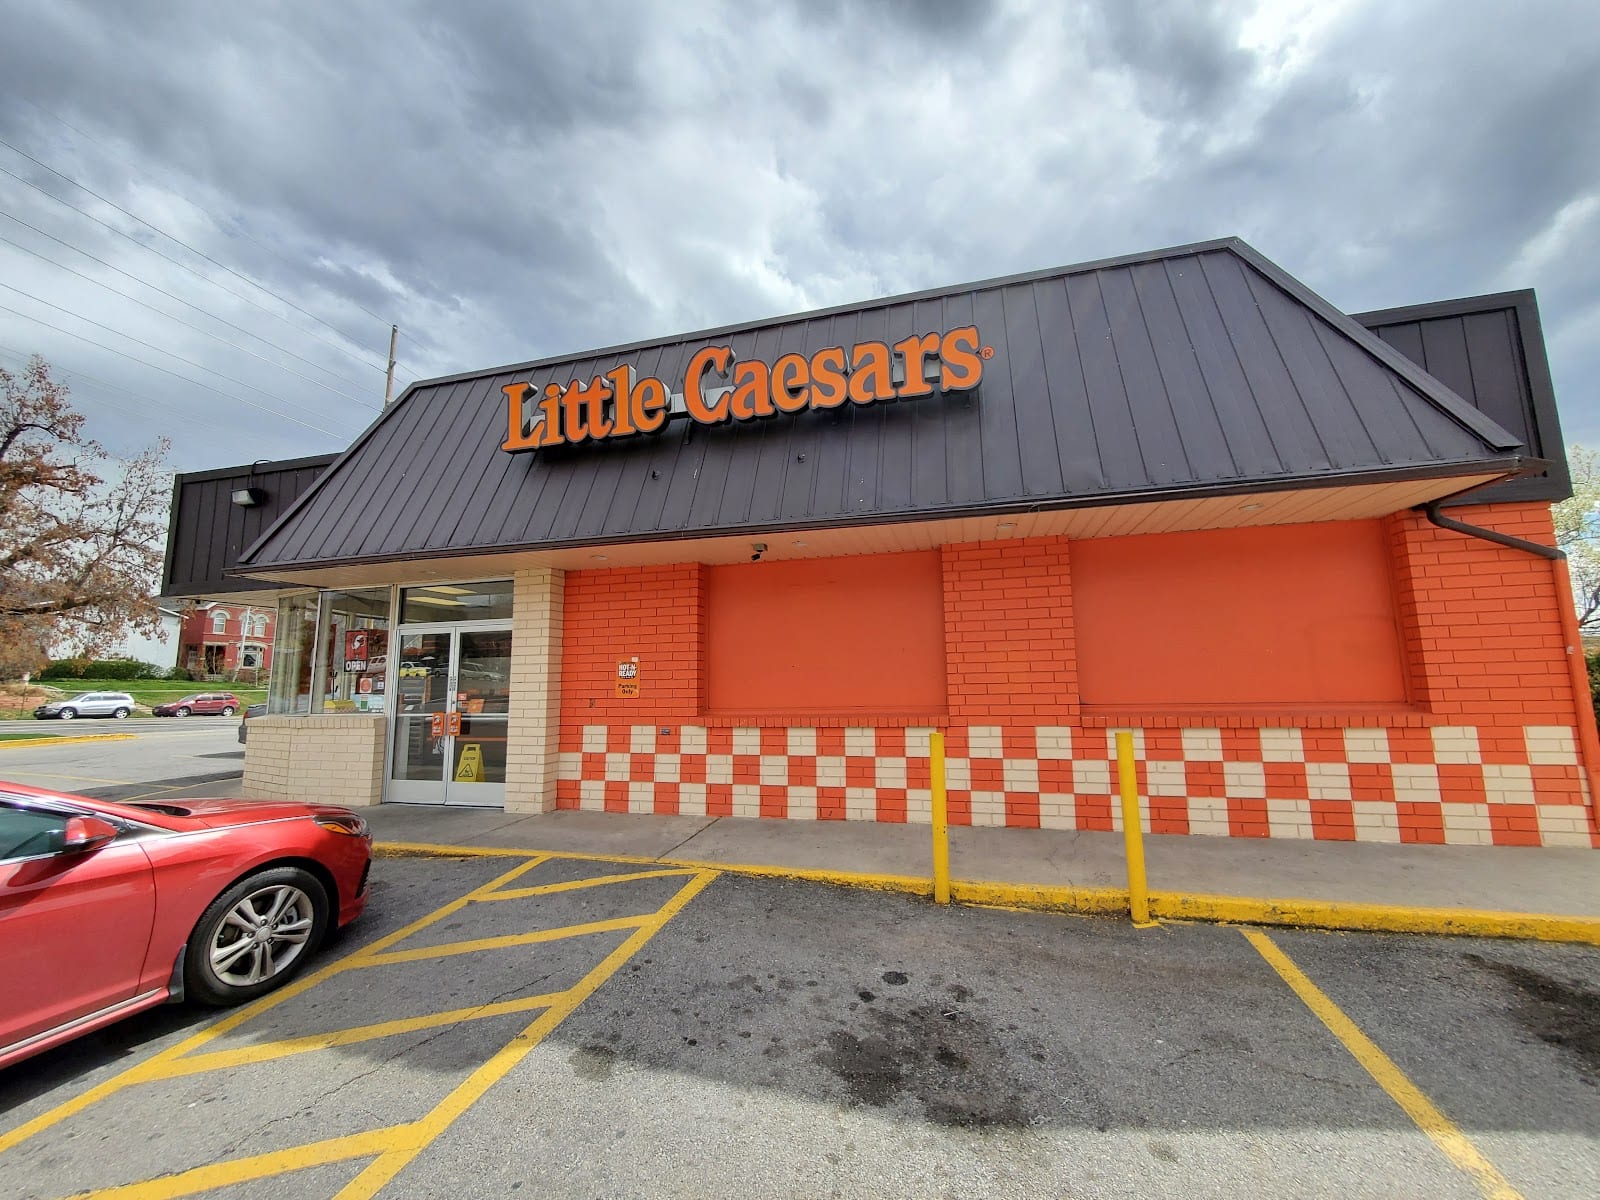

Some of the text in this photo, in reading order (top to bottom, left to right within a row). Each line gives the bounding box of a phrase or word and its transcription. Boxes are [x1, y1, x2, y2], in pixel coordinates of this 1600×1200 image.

[501, 325, 984, 454] Little Caesars
[345, 660, 367, 671] OPEN
